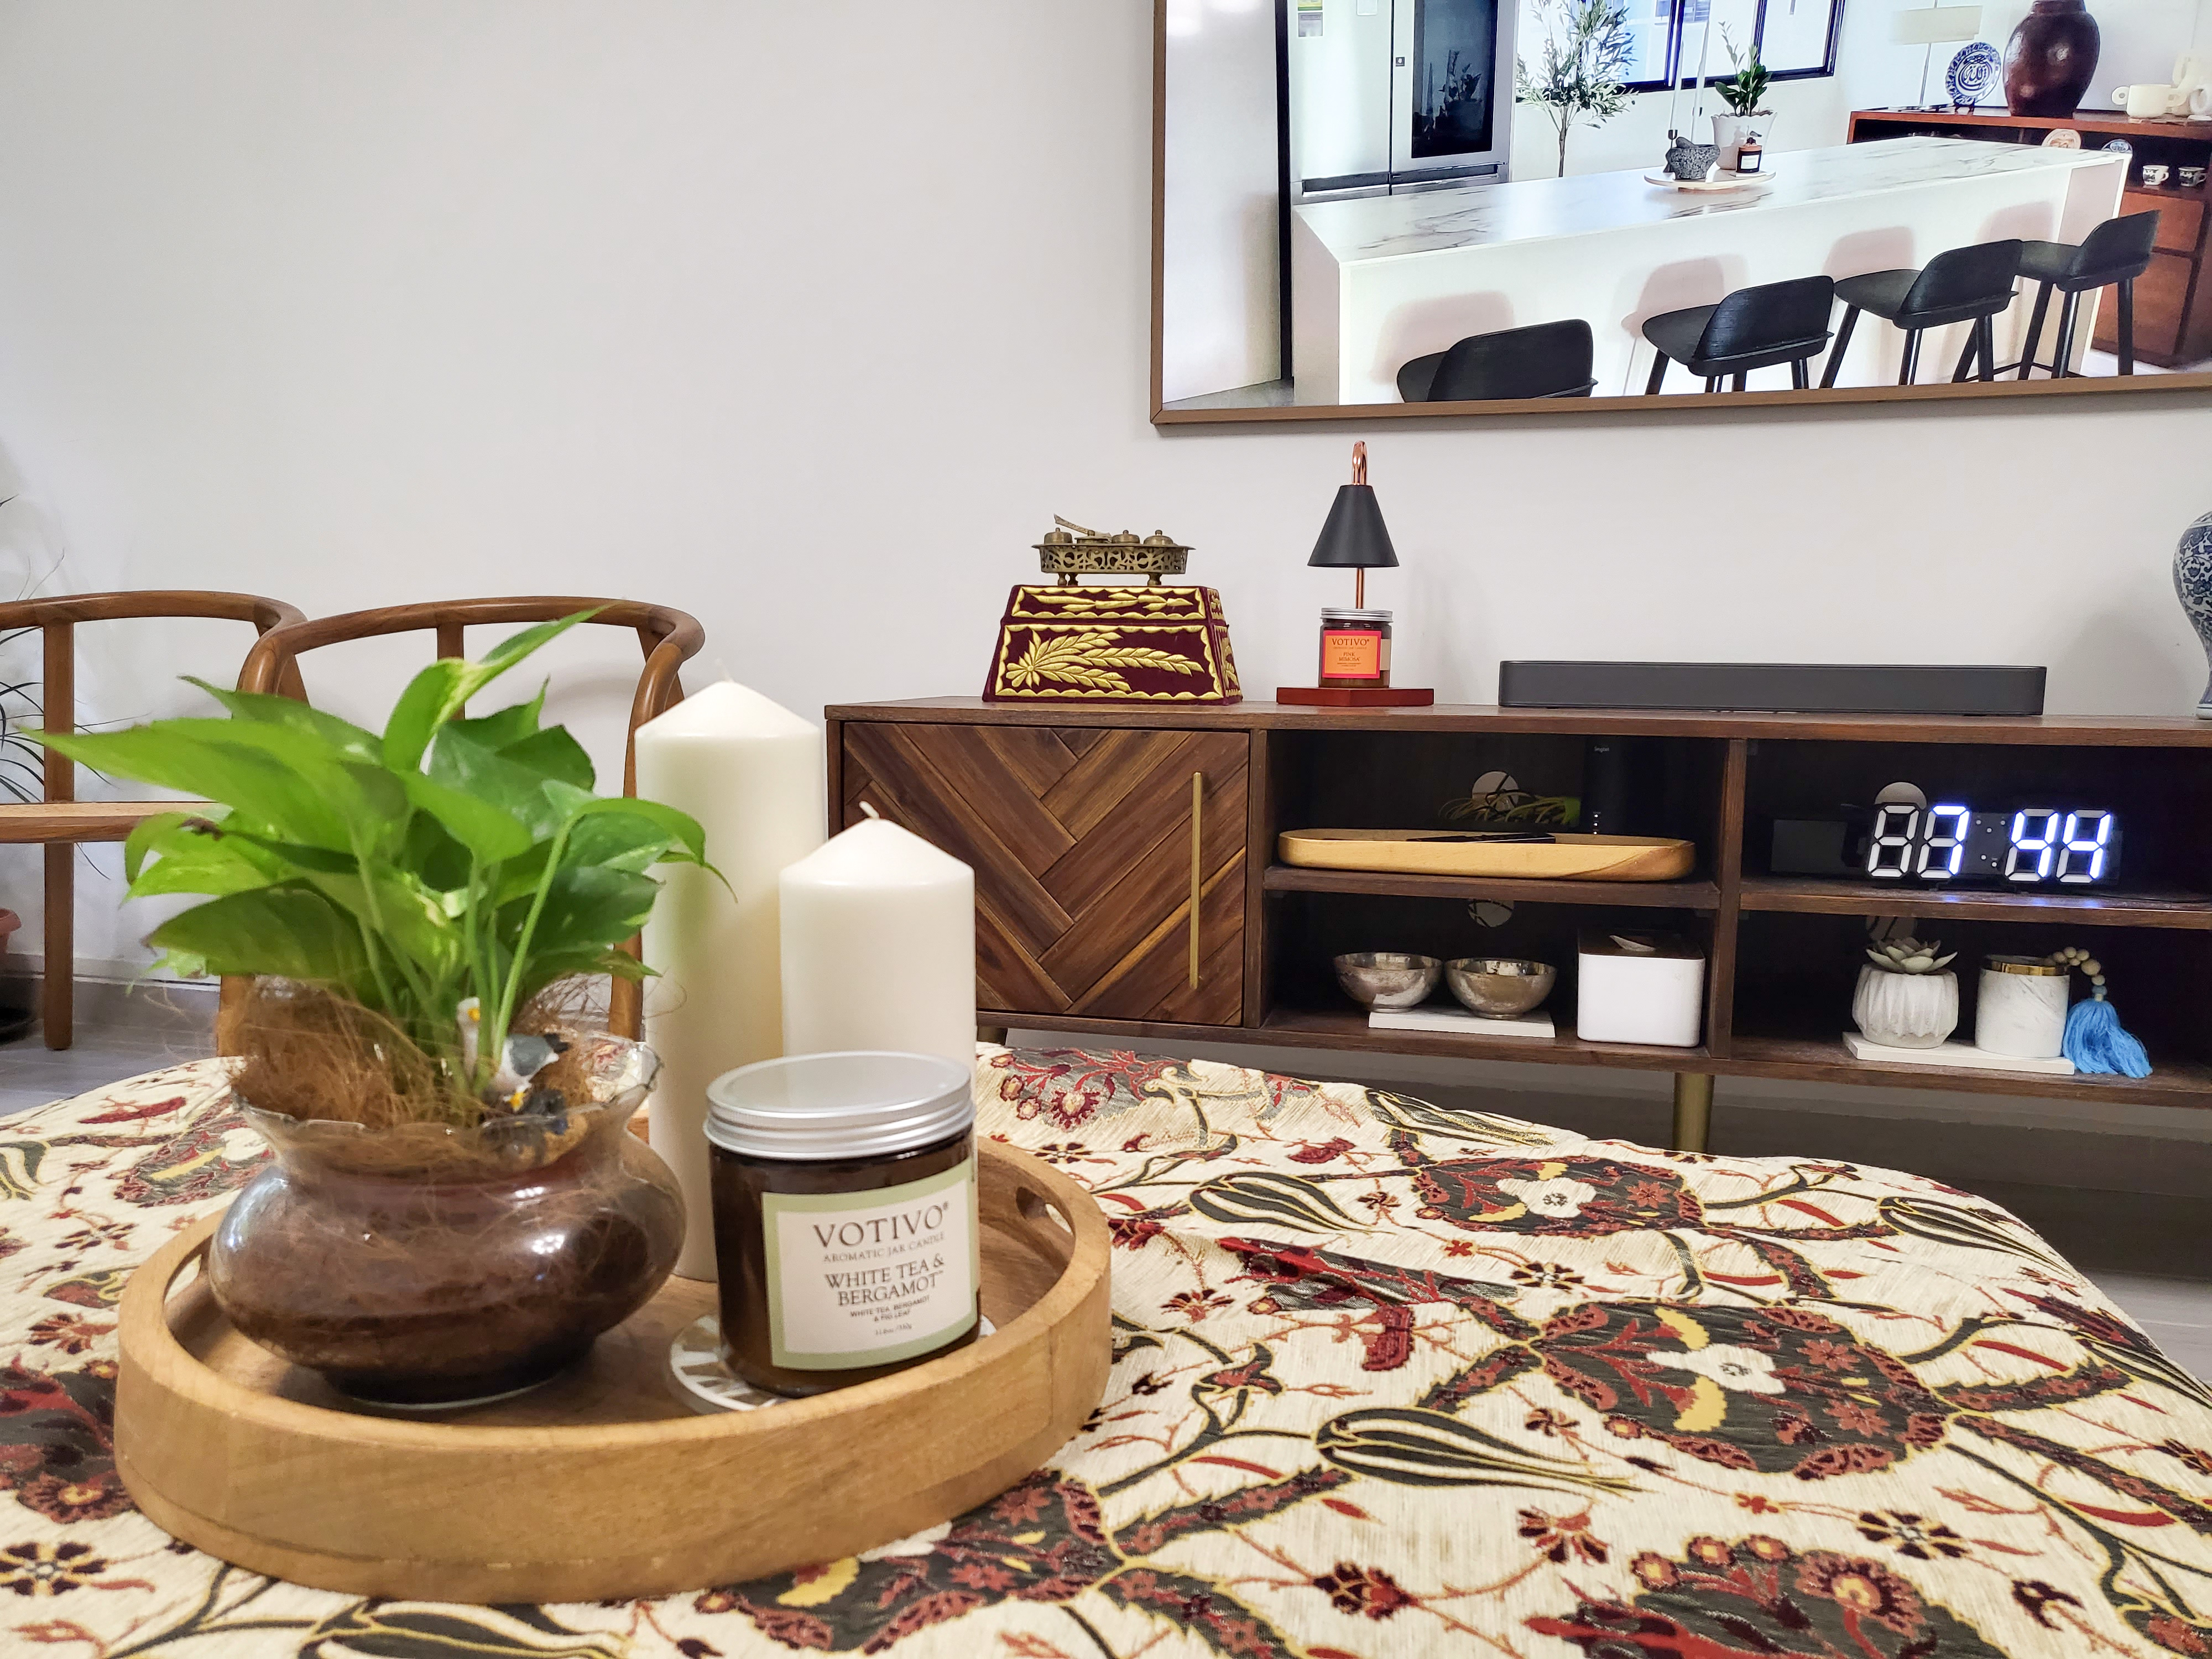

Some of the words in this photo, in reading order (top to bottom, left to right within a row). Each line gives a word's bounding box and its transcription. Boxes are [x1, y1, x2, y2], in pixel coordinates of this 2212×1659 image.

[823, 1249, 885, 1263] AROMATIC
[889, 1244, 906, 1257] JAR
[909, 1231, 945, 1251] CANDLE
[824, 1267, 891, 1288] WHITE
[896, 1259, 930, 1279] TEA
[932, 1253, 945, 1268] &
[850, 1308, 874, 1317] WHITE
